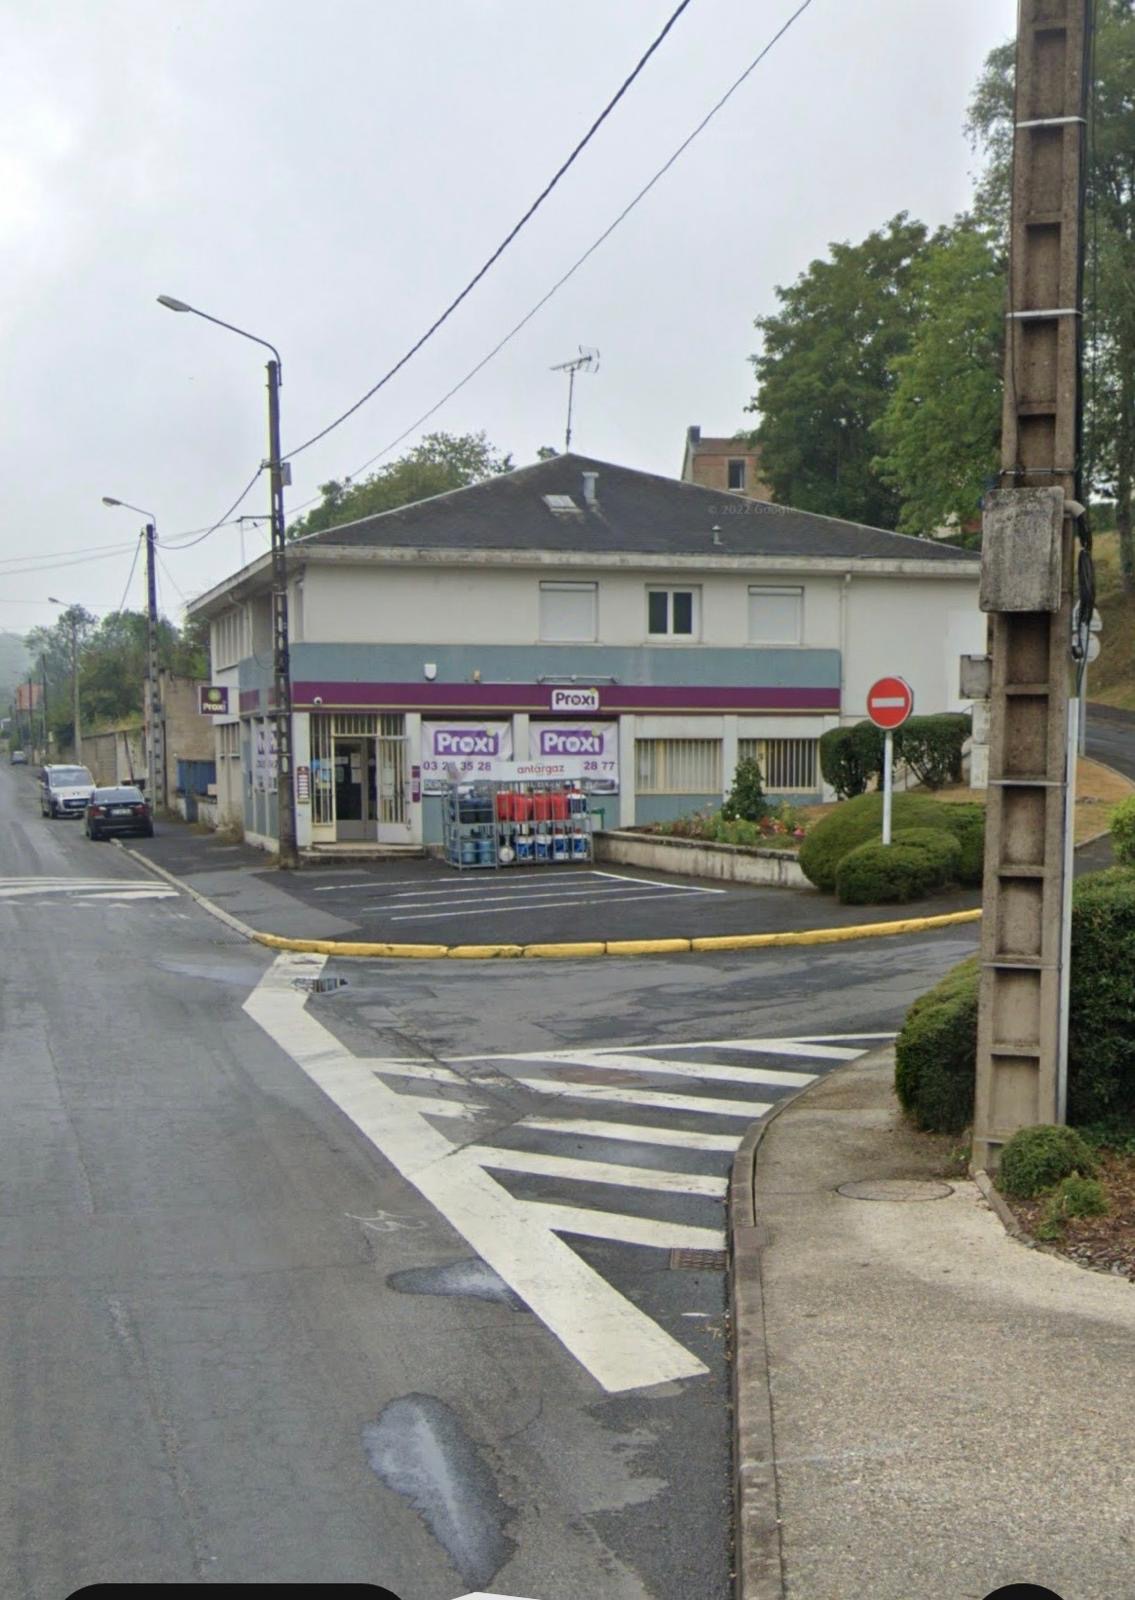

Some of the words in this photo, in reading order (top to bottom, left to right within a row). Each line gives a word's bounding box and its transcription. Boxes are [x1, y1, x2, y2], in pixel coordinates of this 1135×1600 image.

[555, 690, 597, 706] Proxi
[203, 702, 226, 711] Proxi
[437, 728, 495, 753] Proxi
[543, 728, 600, 753] Proxi
[423, 761, 437, 770] 03
[461, 761, 473, 771] 35
[517, 764, 565, 775] antargaz
[584, 761, 597, 771] 28
[602, 761, 615, 771] 77
